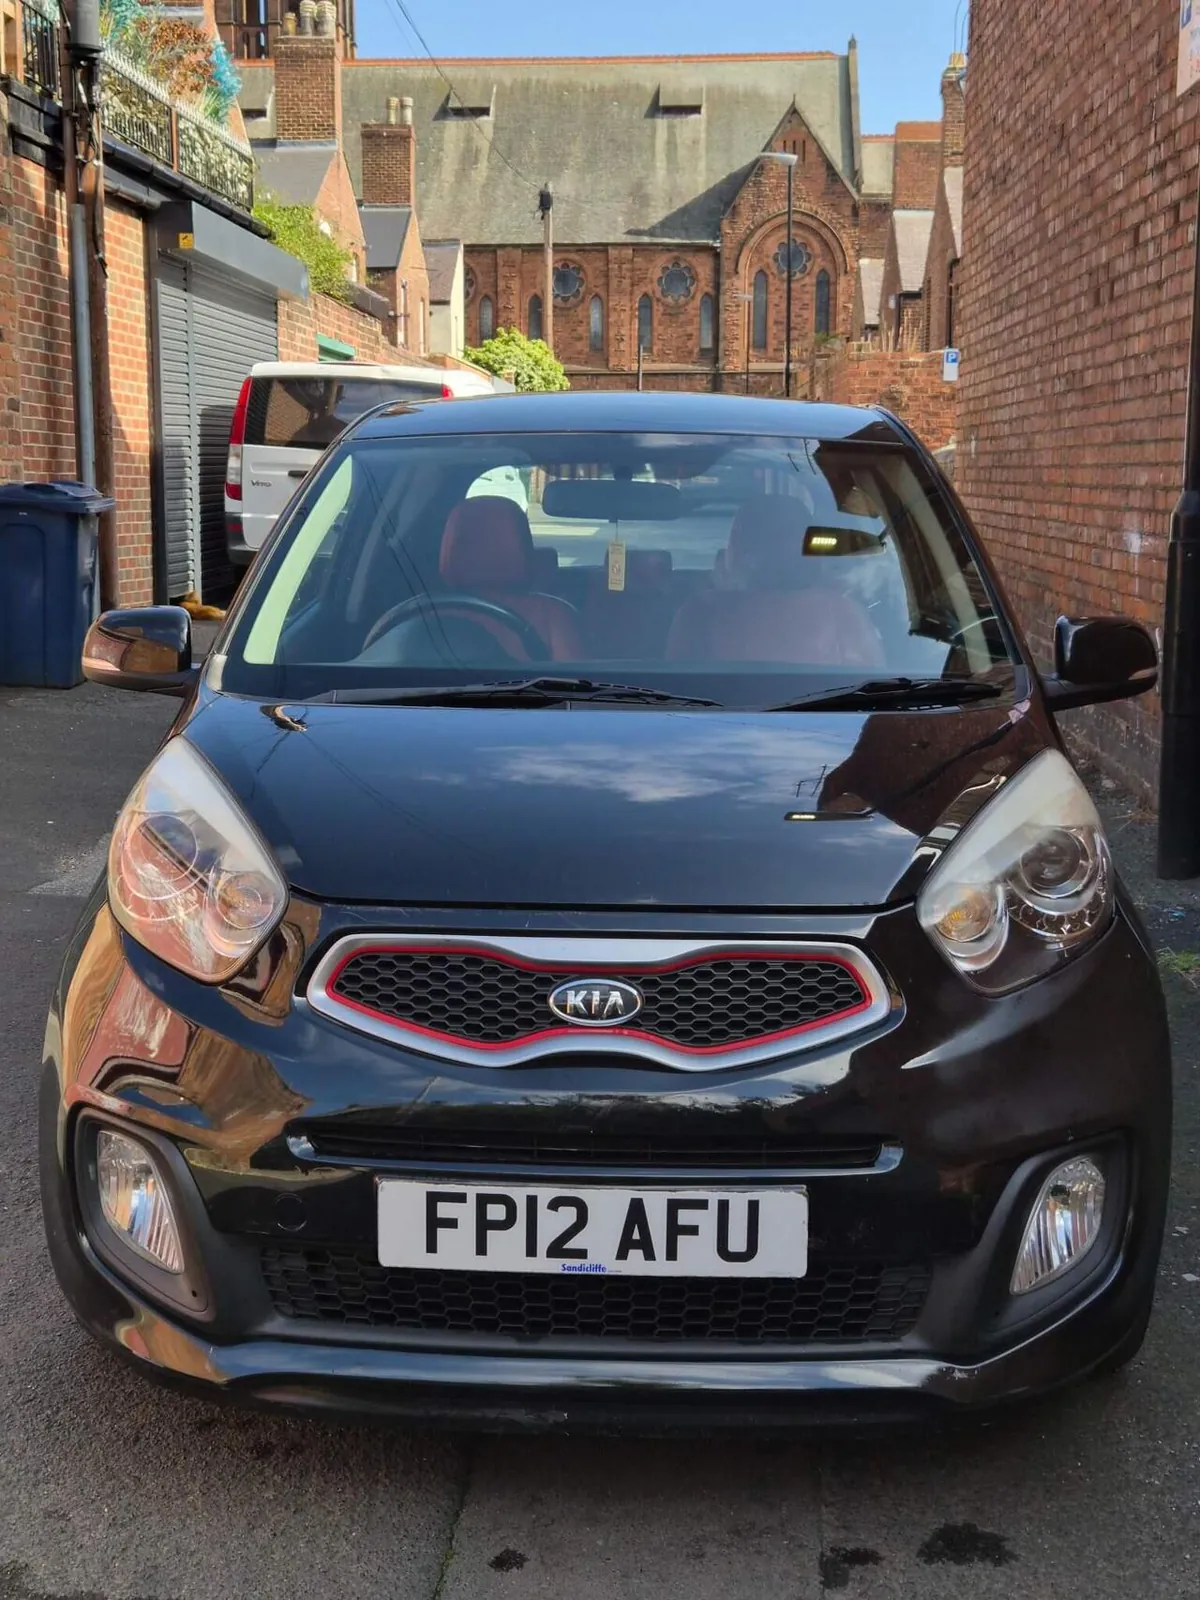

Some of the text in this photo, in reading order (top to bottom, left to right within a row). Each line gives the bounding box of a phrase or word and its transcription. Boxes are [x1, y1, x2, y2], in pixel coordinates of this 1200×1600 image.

[566, 990, 624, 1018] KIA
[425, 1191, 760, 1263] FP12 AFU
[561, 1263, 607, 1273] Sandicliffe
